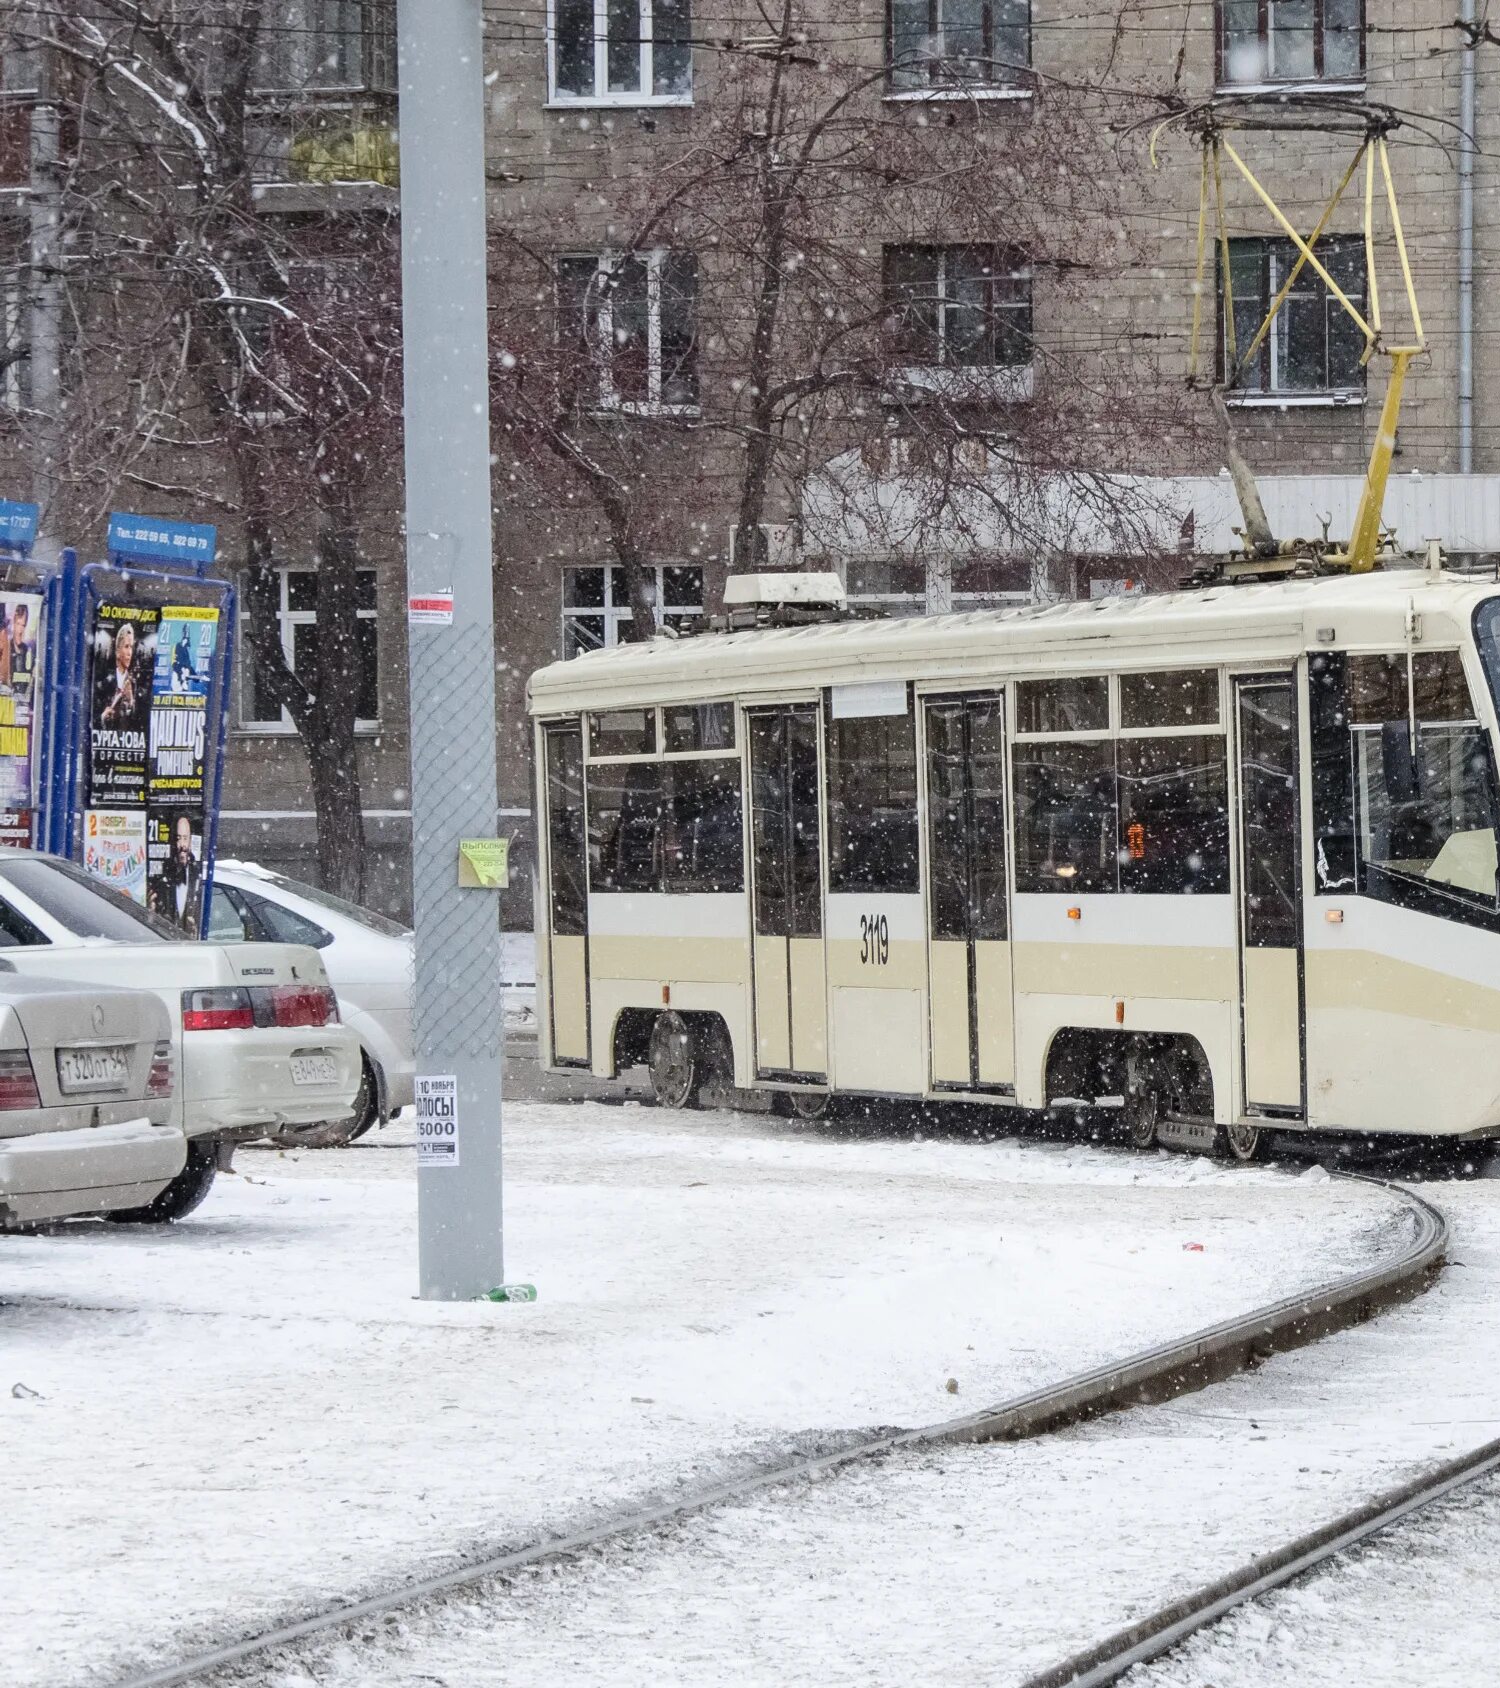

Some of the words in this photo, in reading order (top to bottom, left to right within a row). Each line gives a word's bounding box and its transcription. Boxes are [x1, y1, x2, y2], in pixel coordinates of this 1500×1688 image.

[101, 605, 111, 618] 30
[160, 622, 171, 643] 21
[200, 623, 212, 646] 20
[92, 729, 146, 749] СУРГАНОВА
[149, 710, 207, 760] NAUTILUS
[100, 751, 145, 761] ОРКЕСТР
[90, 815, 97, 836] 2
[148, 819, 159, 841] 21
[86, 845, 145, 877] БАРБАРИКИ
[860, 914, 889, 966] 3119
[431, 1081, 455, 1091] НОЯБРЯ
